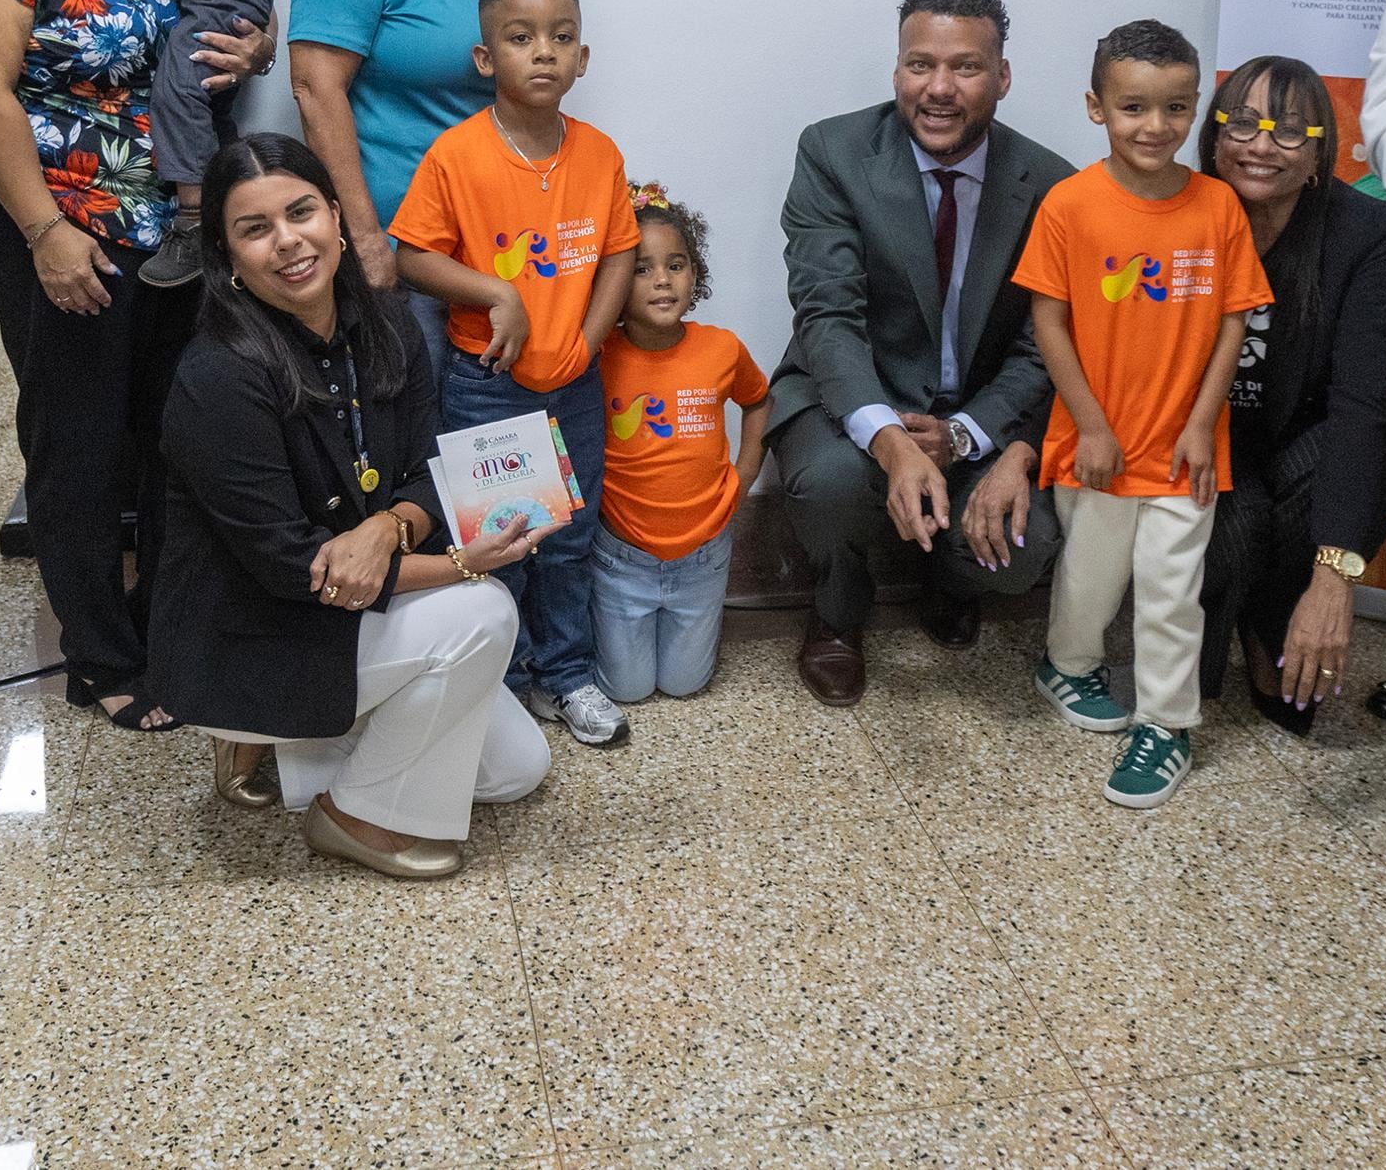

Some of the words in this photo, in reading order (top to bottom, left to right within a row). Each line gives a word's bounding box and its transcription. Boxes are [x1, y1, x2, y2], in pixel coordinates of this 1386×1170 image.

[1299, 2, 1344, 10] CAPACIDAD
[580, 217, 595, 227] LOS
[558, 225, 596, 241] DERECHOS
[586, 244, 598, 253] LA
[676, 389, 693, 397] RED
[693, 388, 708, 397] POR
[677, 396, 718, 407] DERECHOS
[677, 421, 716, 434] JUVENTUD
[472, 452, 532, 480] amor
[481, 478, 496, 487] DE
